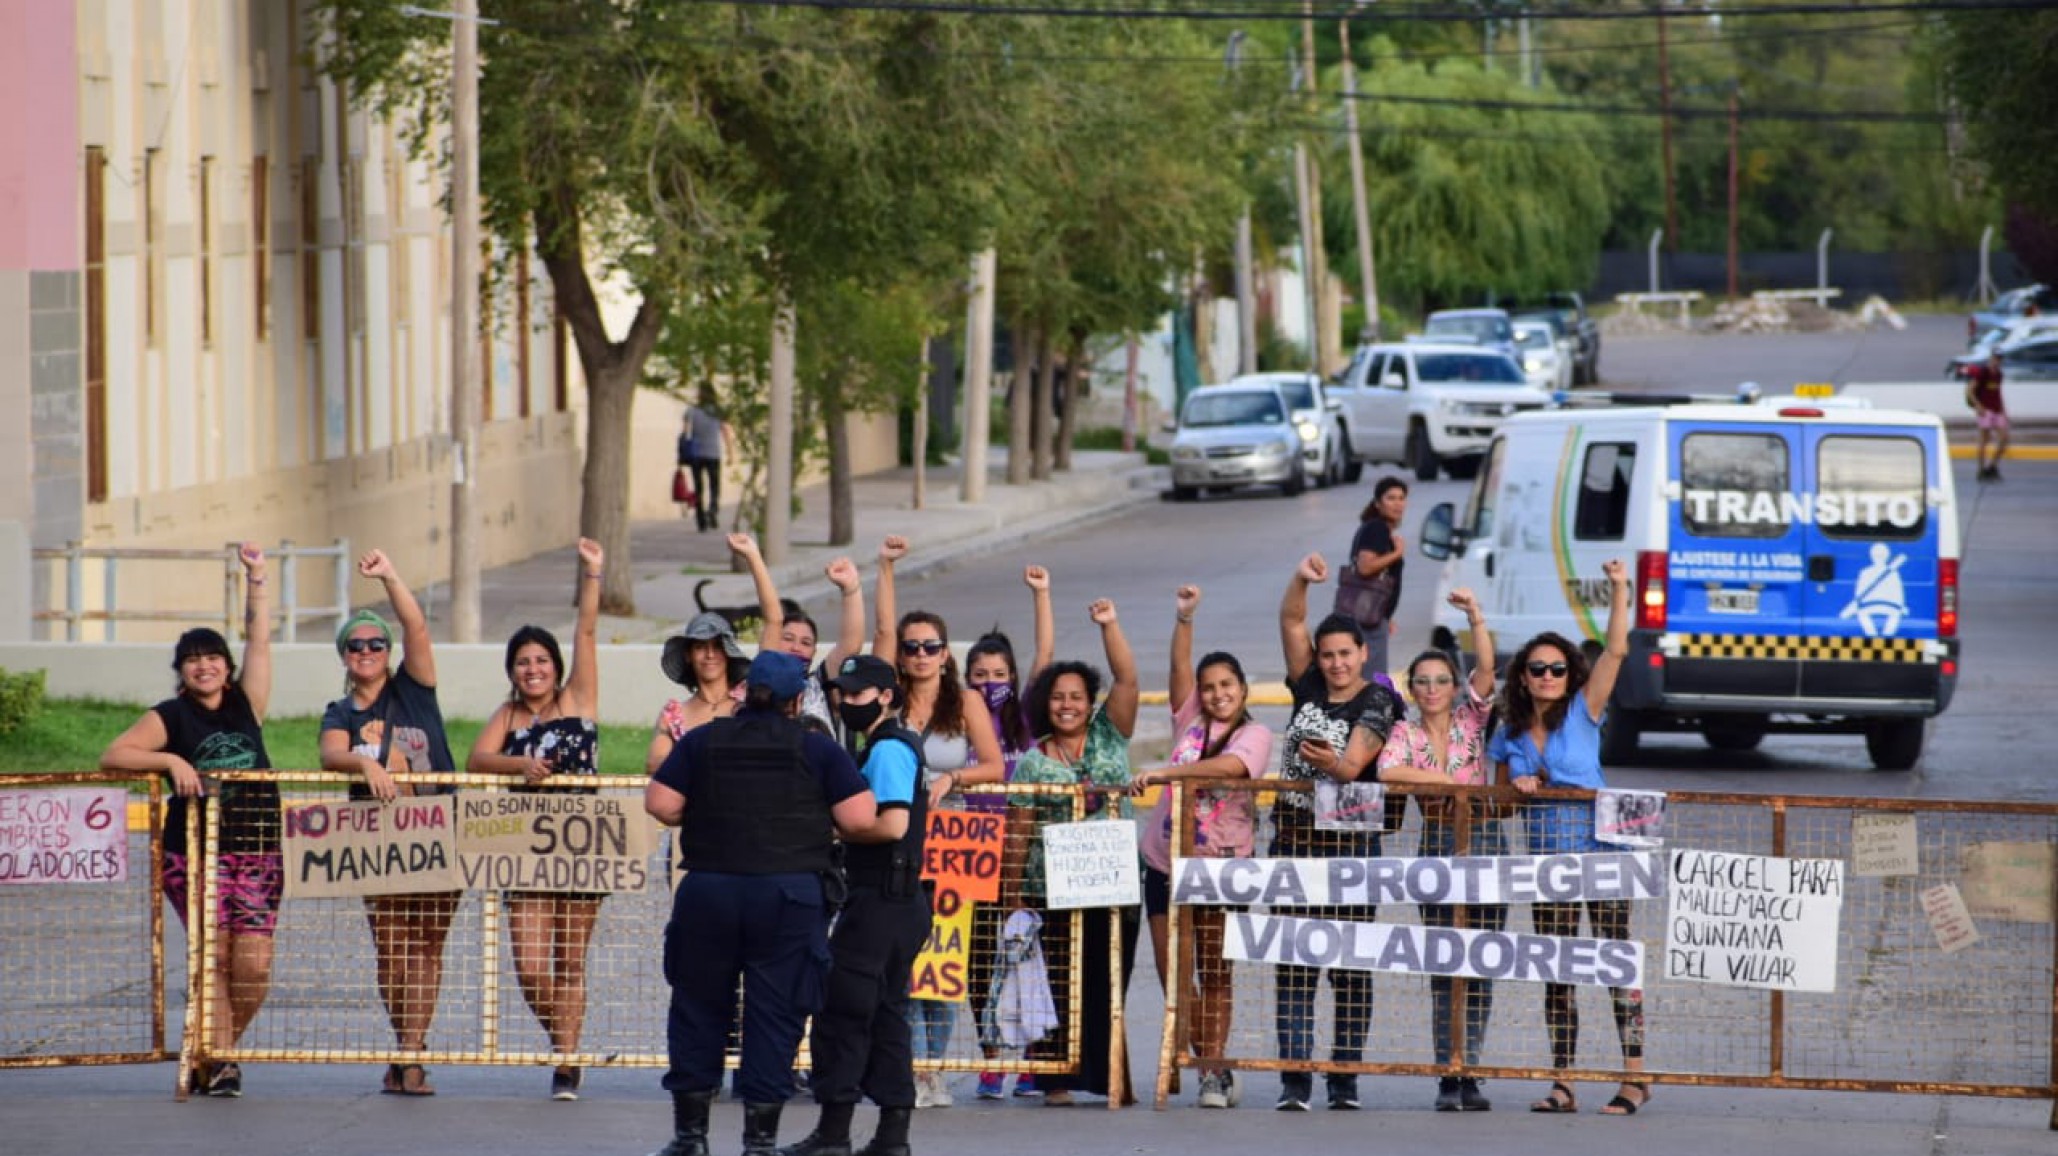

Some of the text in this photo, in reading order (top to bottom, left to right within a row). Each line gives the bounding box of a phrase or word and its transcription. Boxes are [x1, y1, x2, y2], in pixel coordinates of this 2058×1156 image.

[1685, 490, 1918, 527] TRANSITO
[85, 796, 112, 830] 6
[286, 804, 445, 838] NO FUE UNA
[465, 797, 624, 819] NO SON HIJOS DEL
[464, 814, 627, 855] PODER SON
[302, 841, 446, 882] MANADA
[459, 854, 646, 890] VIOLADORES
[1174, 854, 1664, 903] ACA PROTEGEN
[1674, 851, 1840, 896] CARCEL PARA
[1677, 888, 1803, 921] MALLEMACCI
[1237, 915, 1638, 986] VIOLADORES
[1669, 949, 1710, 979] DEL
